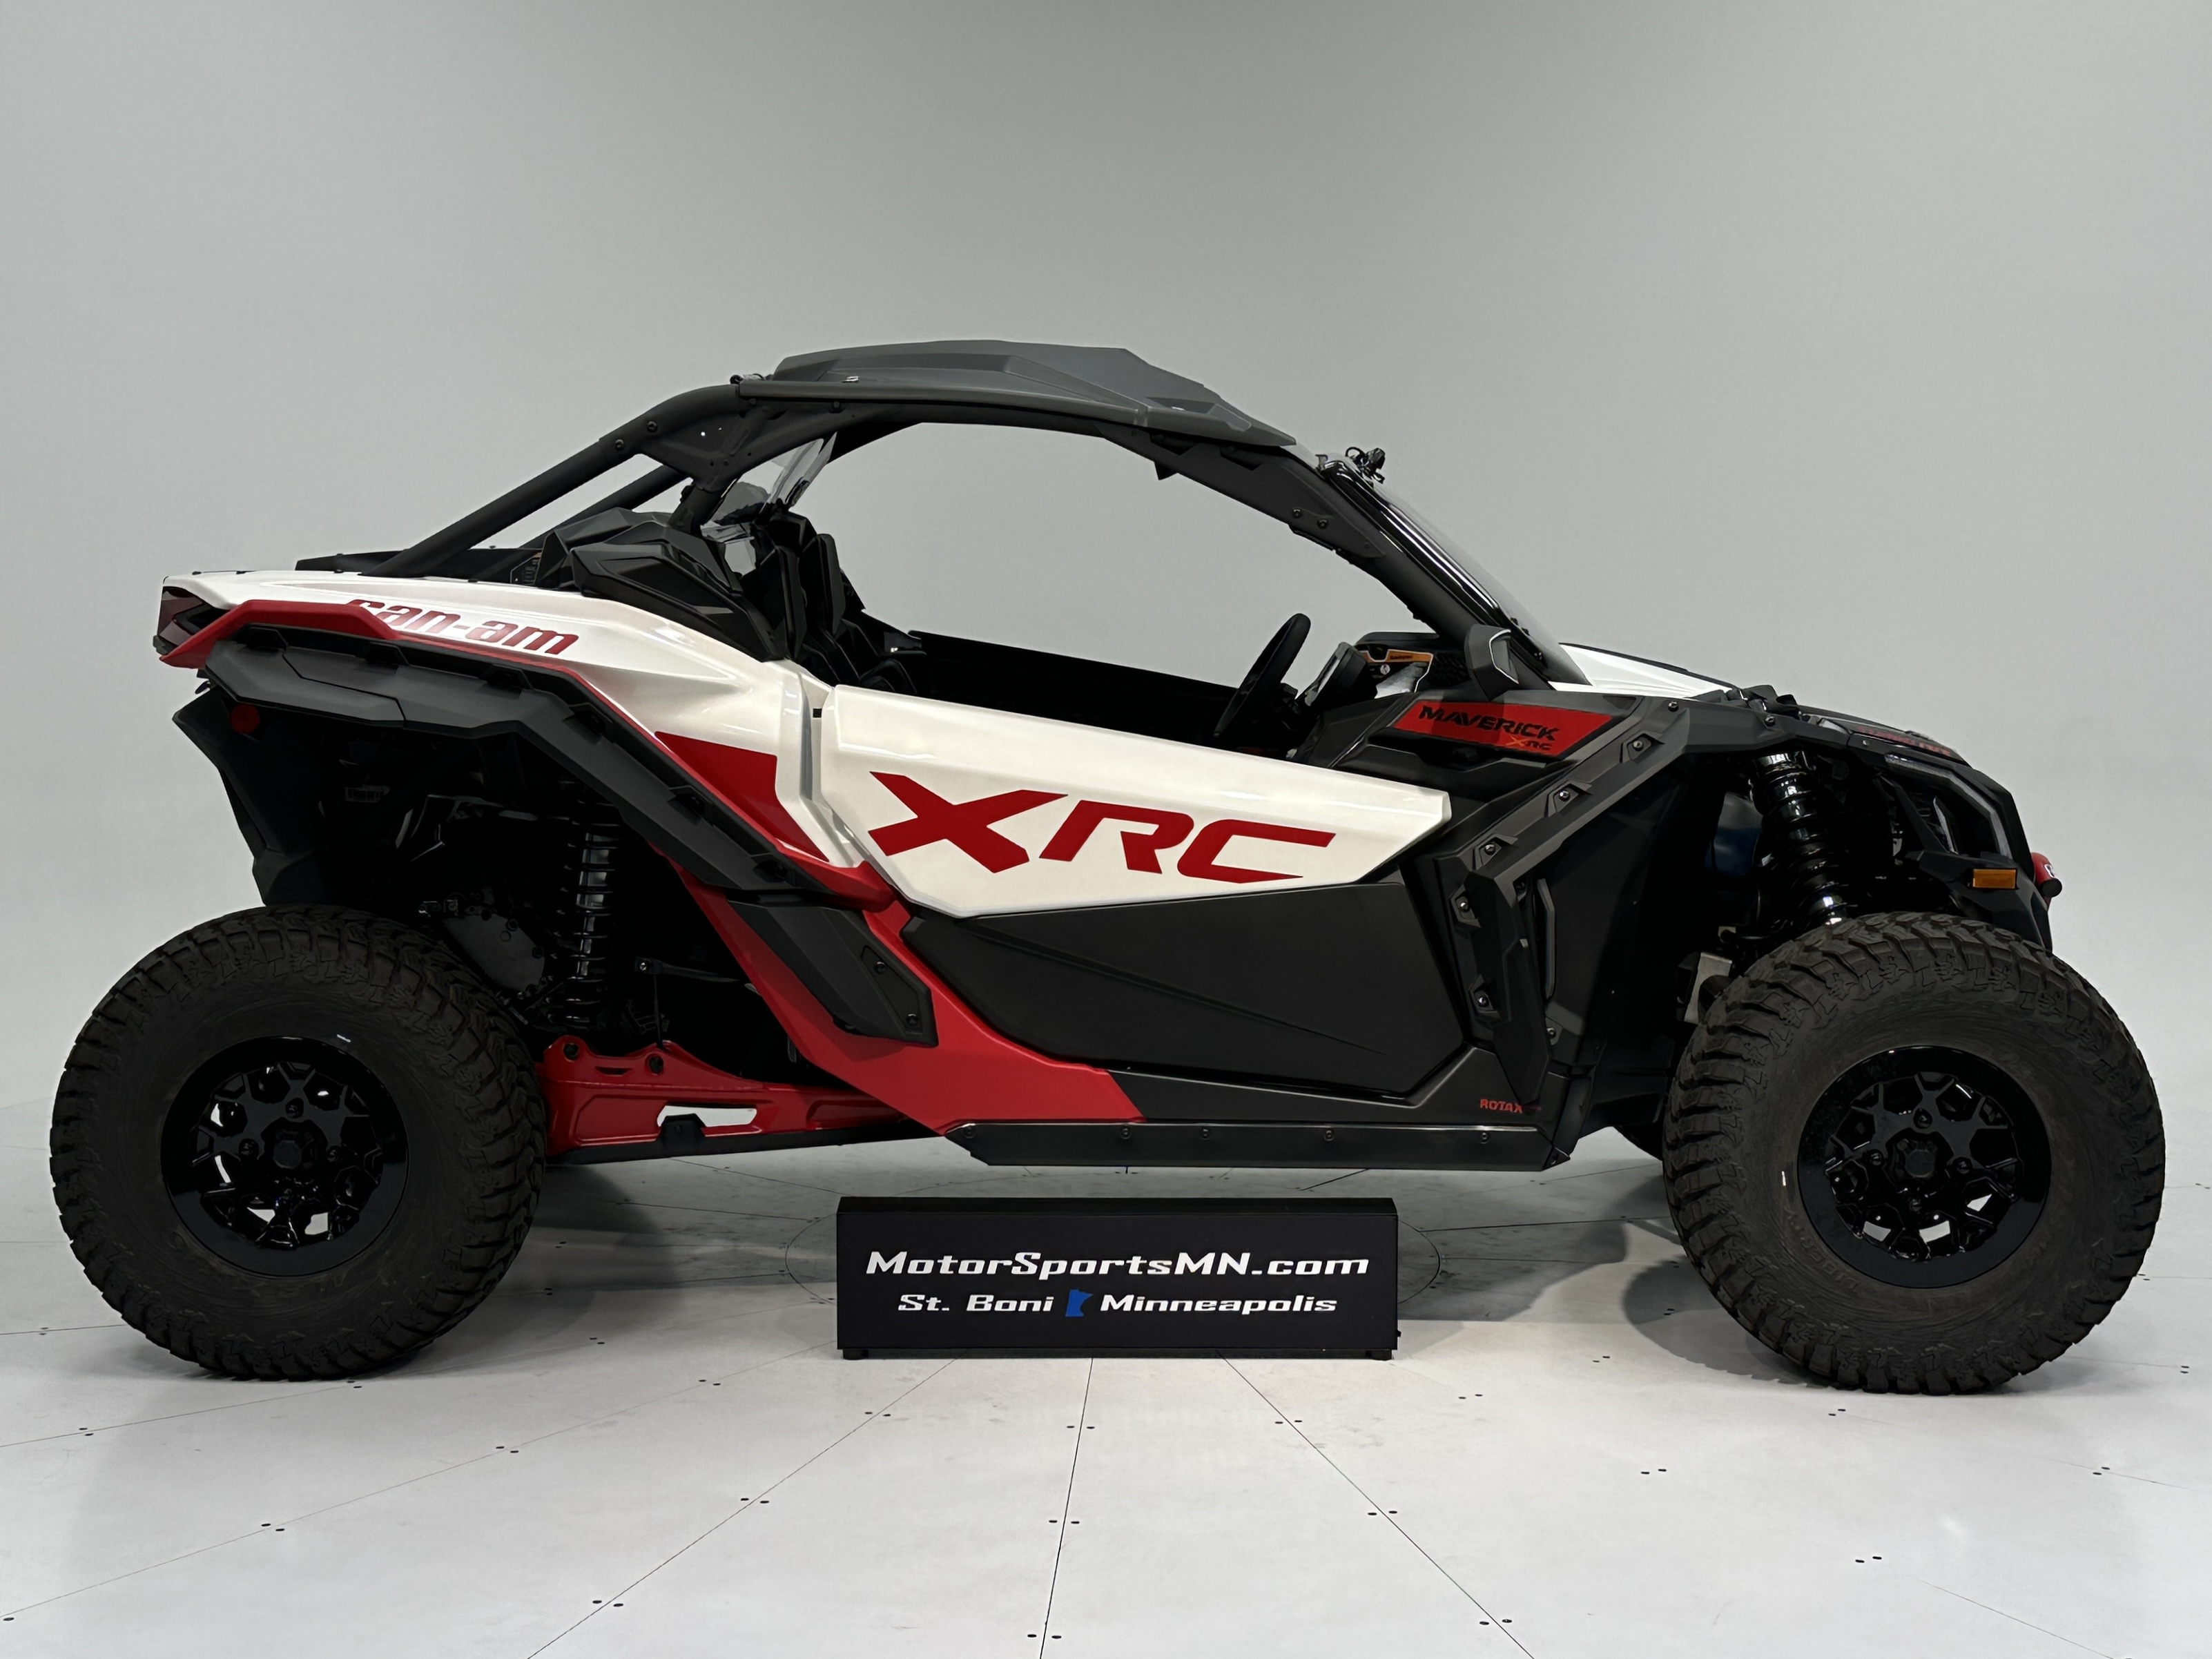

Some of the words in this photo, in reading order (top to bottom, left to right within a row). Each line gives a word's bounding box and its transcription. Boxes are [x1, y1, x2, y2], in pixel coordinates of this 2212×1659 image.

[1419, 705, 1560, 741] MAVERICK
[868, 770, 1336, 884] XRC
[1479, 1098, 1523, 1114] ROTAX
[866, 1251, 1369, 1281] MotorSportsMN.com
[898, 1294, 950, 1312] St.
[966, 1294, 1054, 1312] Boni
[1100, 1294, 1337, 1315] Minneapolis
